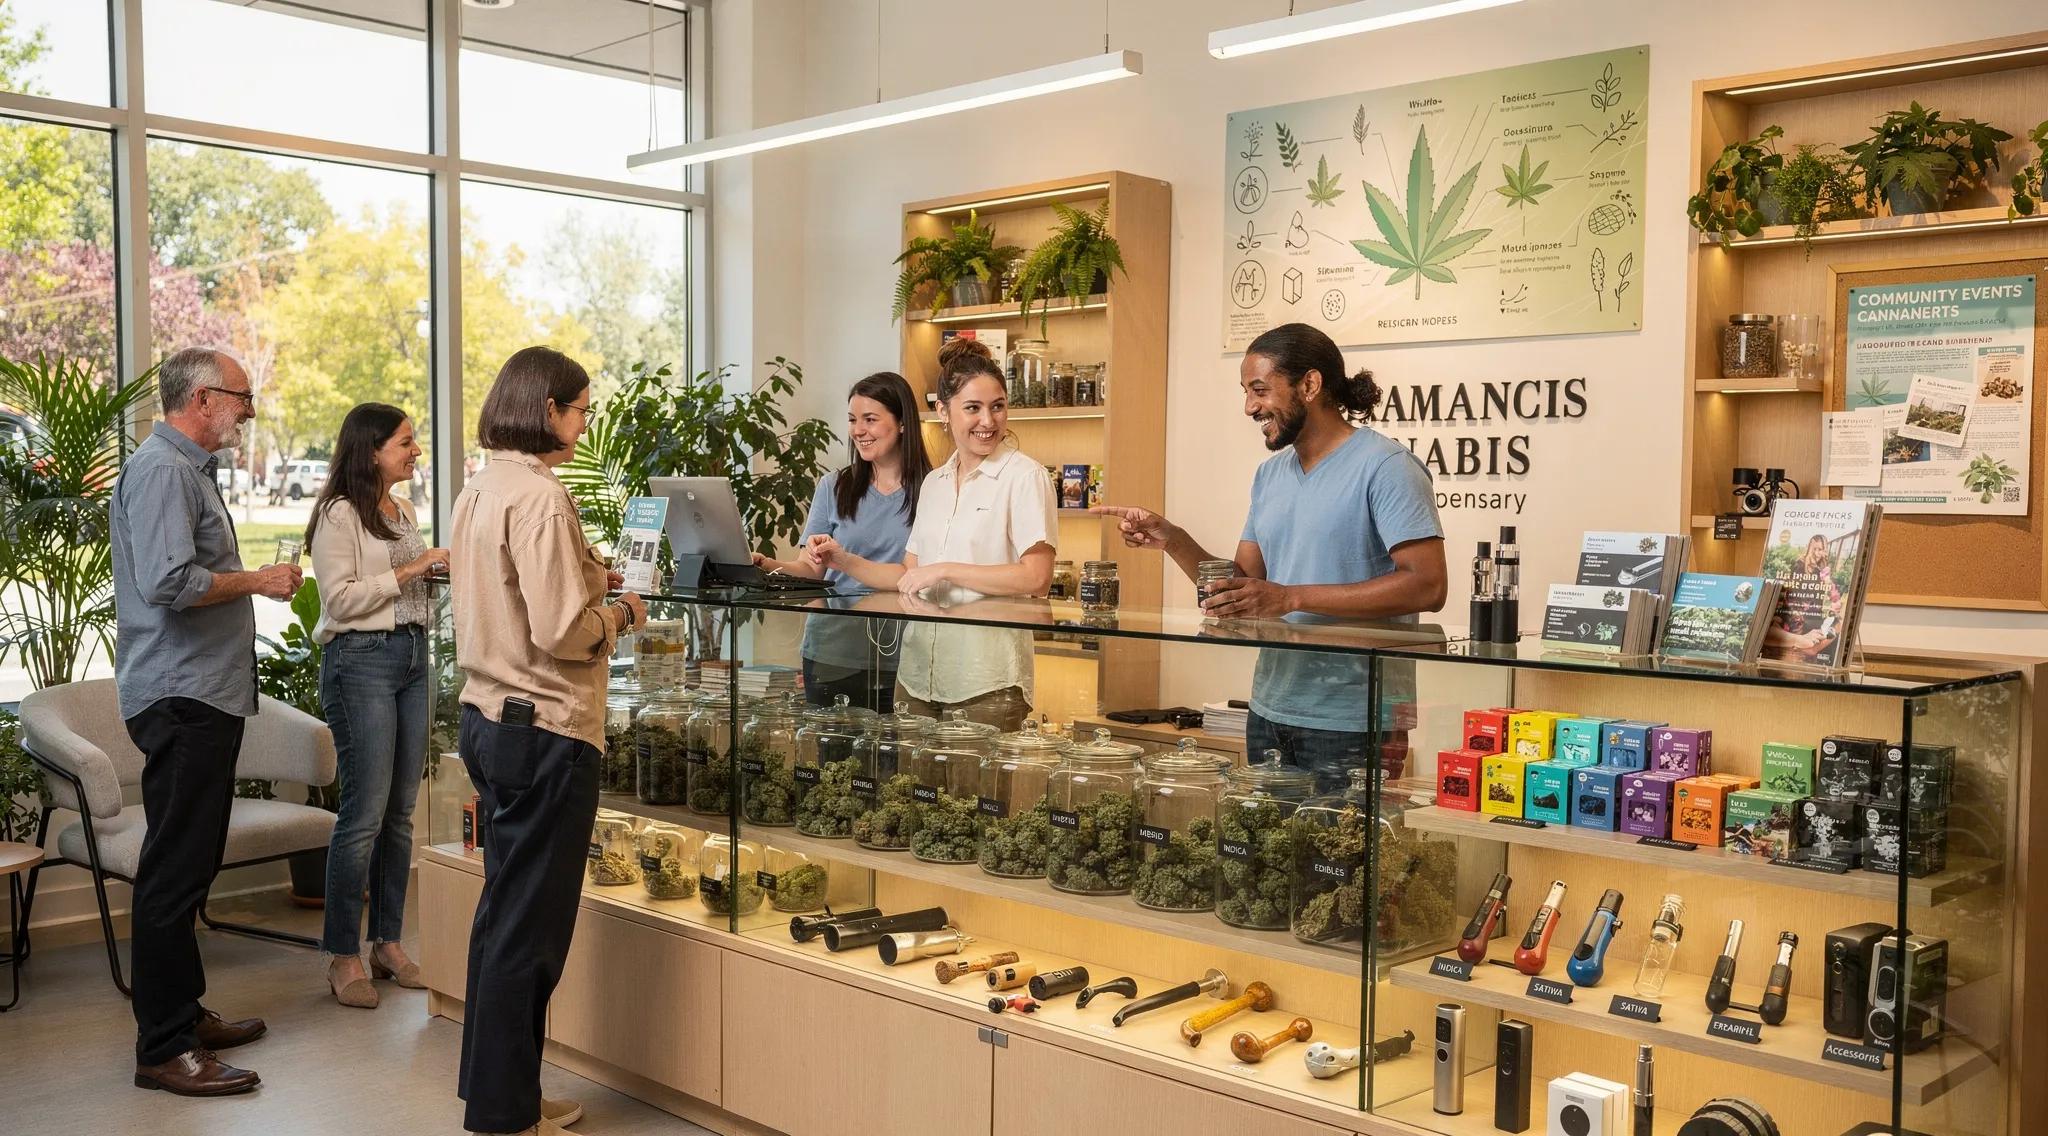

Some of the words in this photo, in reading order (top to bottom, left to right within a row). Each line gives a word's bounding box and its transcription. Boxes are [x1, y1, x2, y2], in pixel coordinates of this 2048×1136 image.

[1857, 288, 1958, 307] COMMUNITY
[1961, 284, 2023, 301] EVENTS
[1857, 305, 1960, 323] CANNANERTS
[1223, 843, 1247, 856] INDICA
[1314, 863, 1345, 877] EDIBLES
